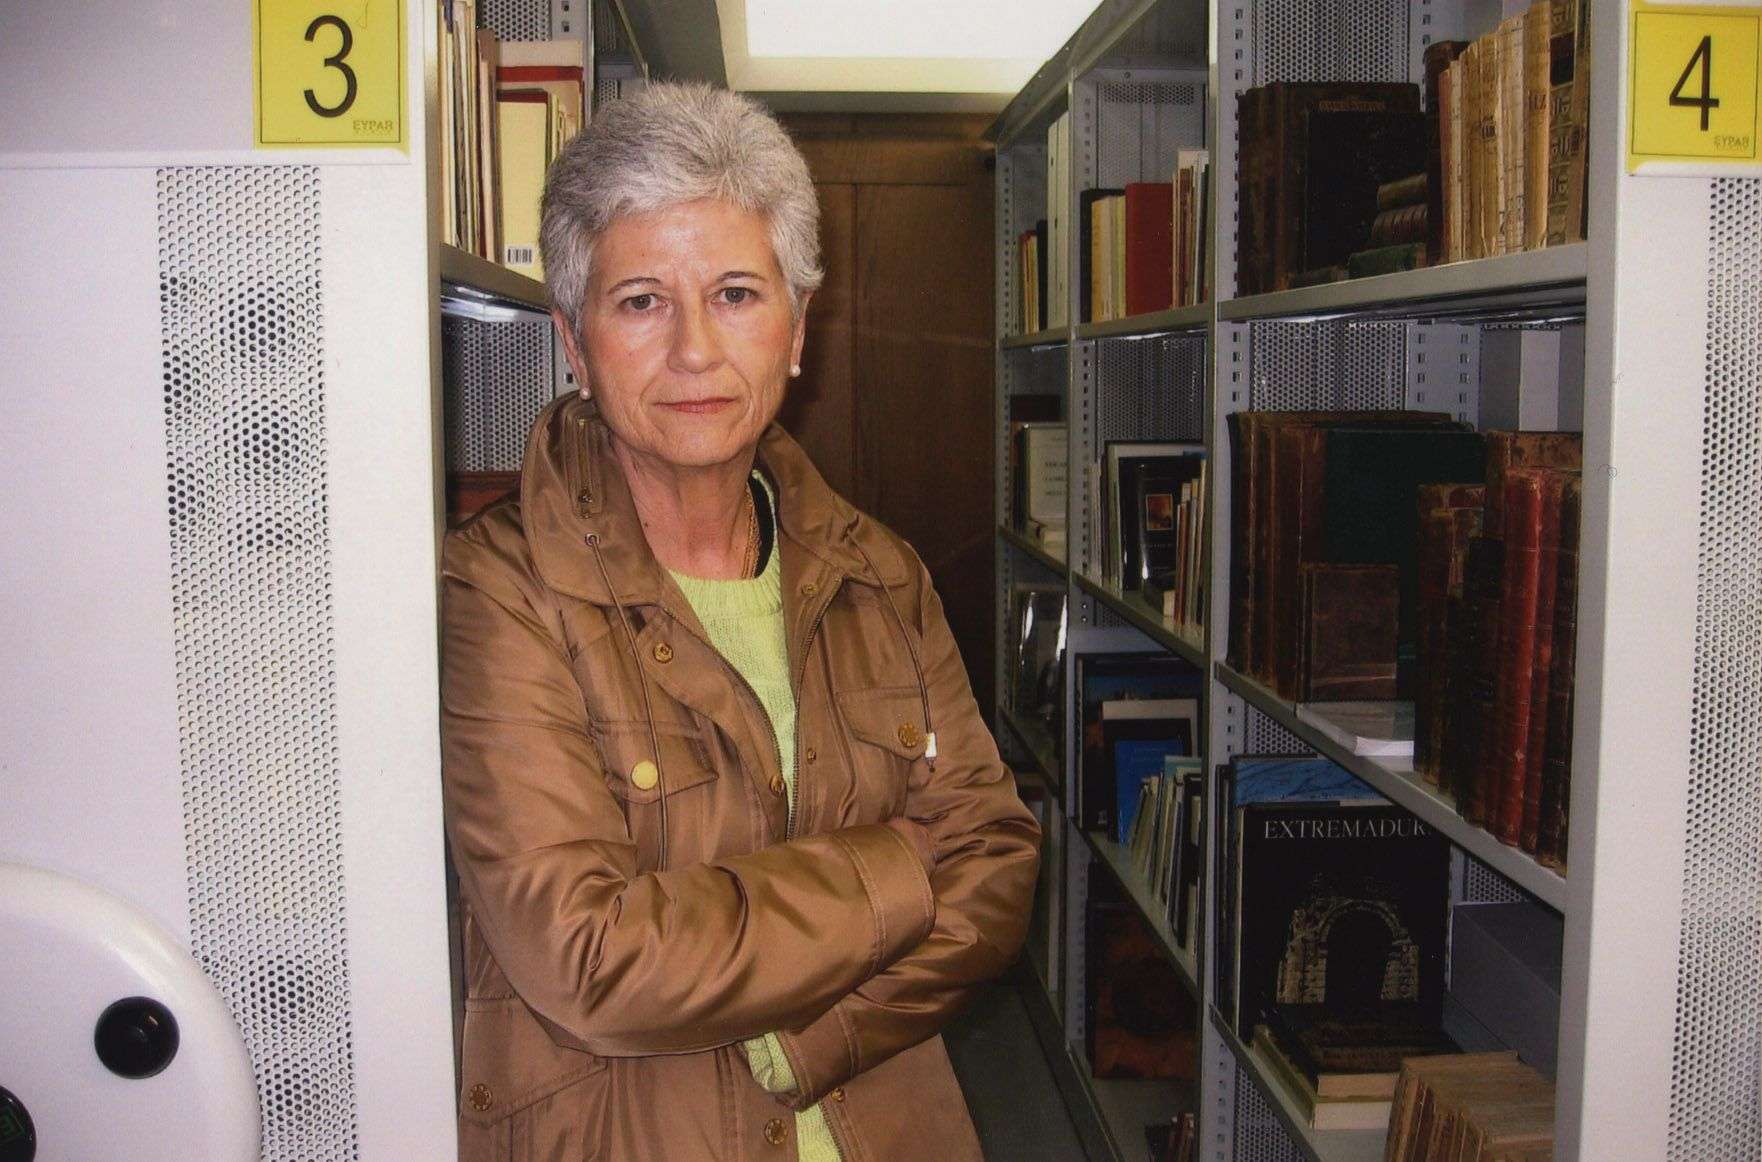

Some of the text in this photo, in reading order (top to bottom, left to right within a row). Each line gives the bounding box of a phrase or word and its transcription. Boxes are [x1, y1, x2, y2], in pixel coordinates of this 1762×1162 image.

[304, 15, 358, 118] 3
[1669, 35, 1720, 131] 4
[352, 120, 393, 130] EYPAR
[1264, 818, 1431, 839] EXTREMADUR
